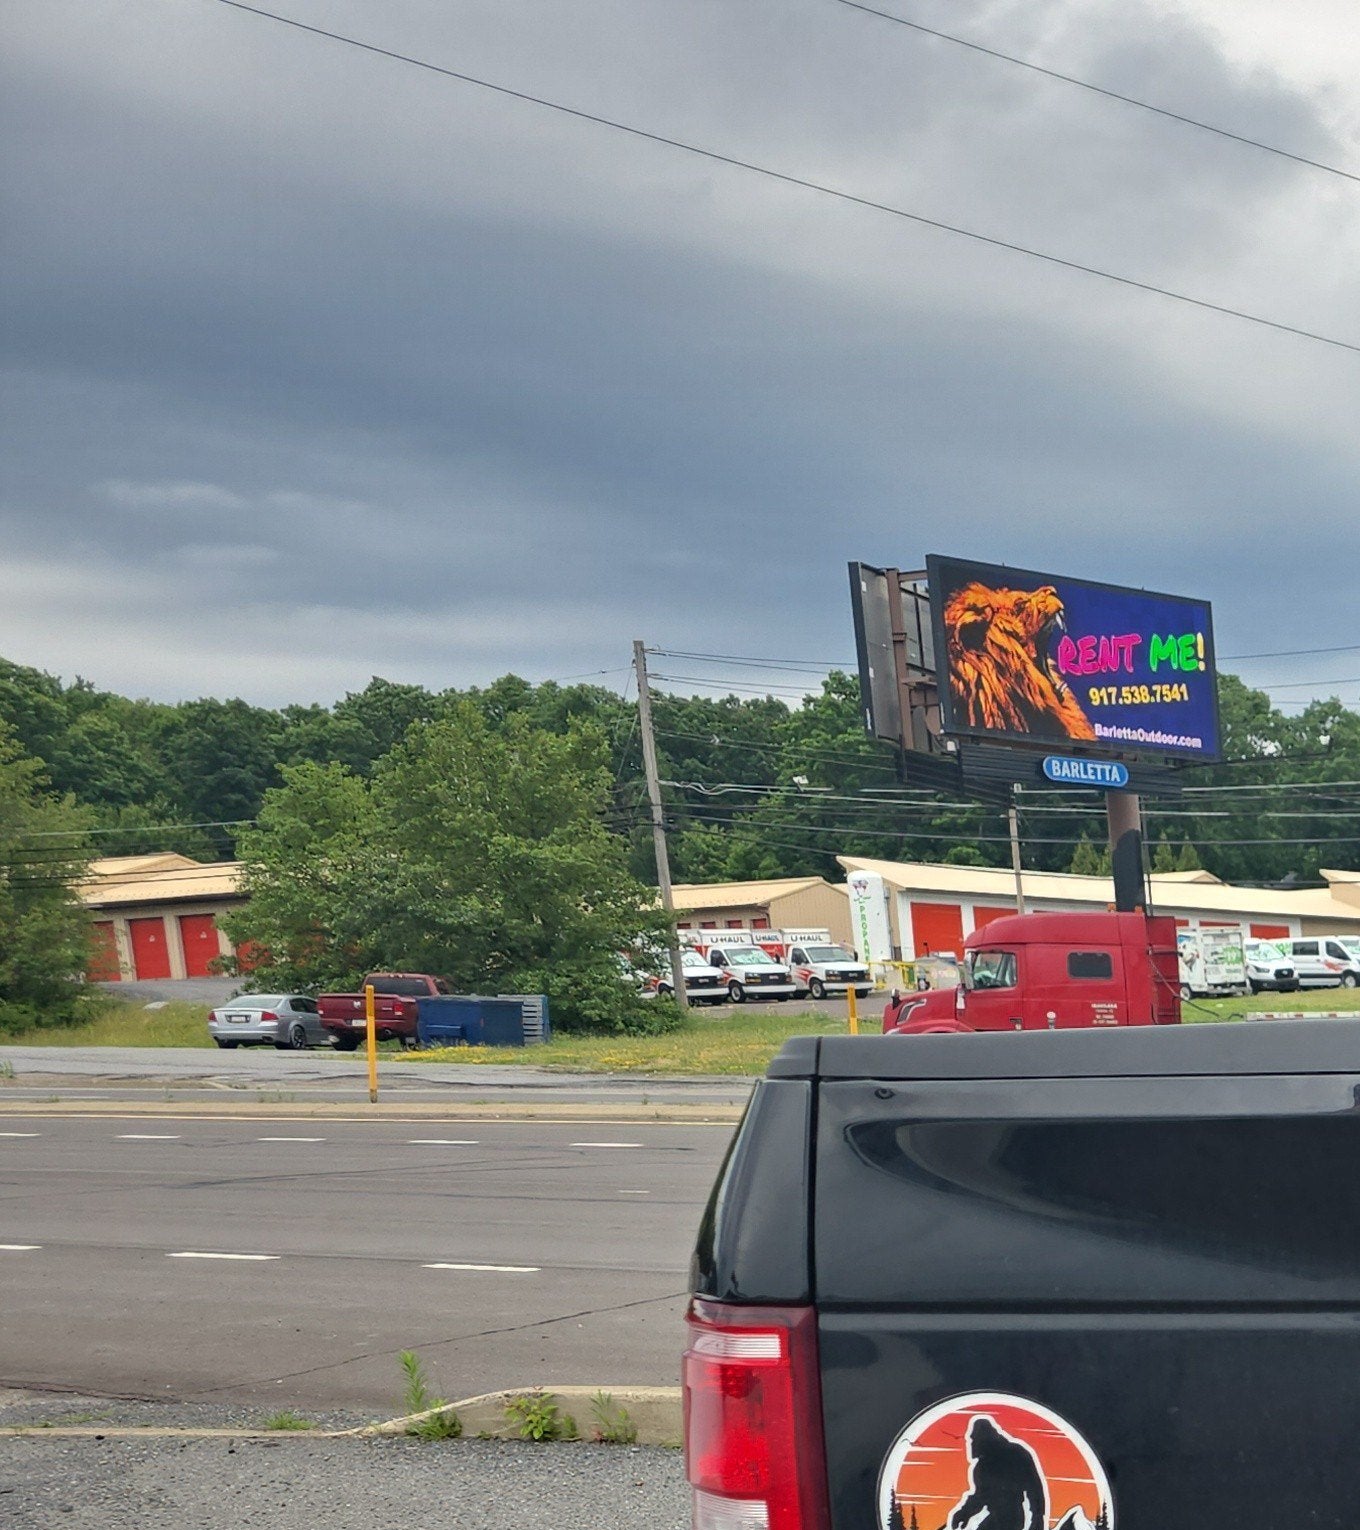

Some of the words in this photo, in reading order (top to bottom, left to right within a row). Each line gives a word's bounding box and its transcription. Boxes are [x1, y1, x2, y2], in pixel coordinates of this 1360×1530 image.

[1058, 633, 1142, 676] RENT
[1150, 632, 1206, 672] ME!
[1089, 683, 1189, 706] 917.538.7541
[1094, 723, 1202, 748] BarlettaOutdoor.com
[1052, 760, 1121, 782] BARLETTA
